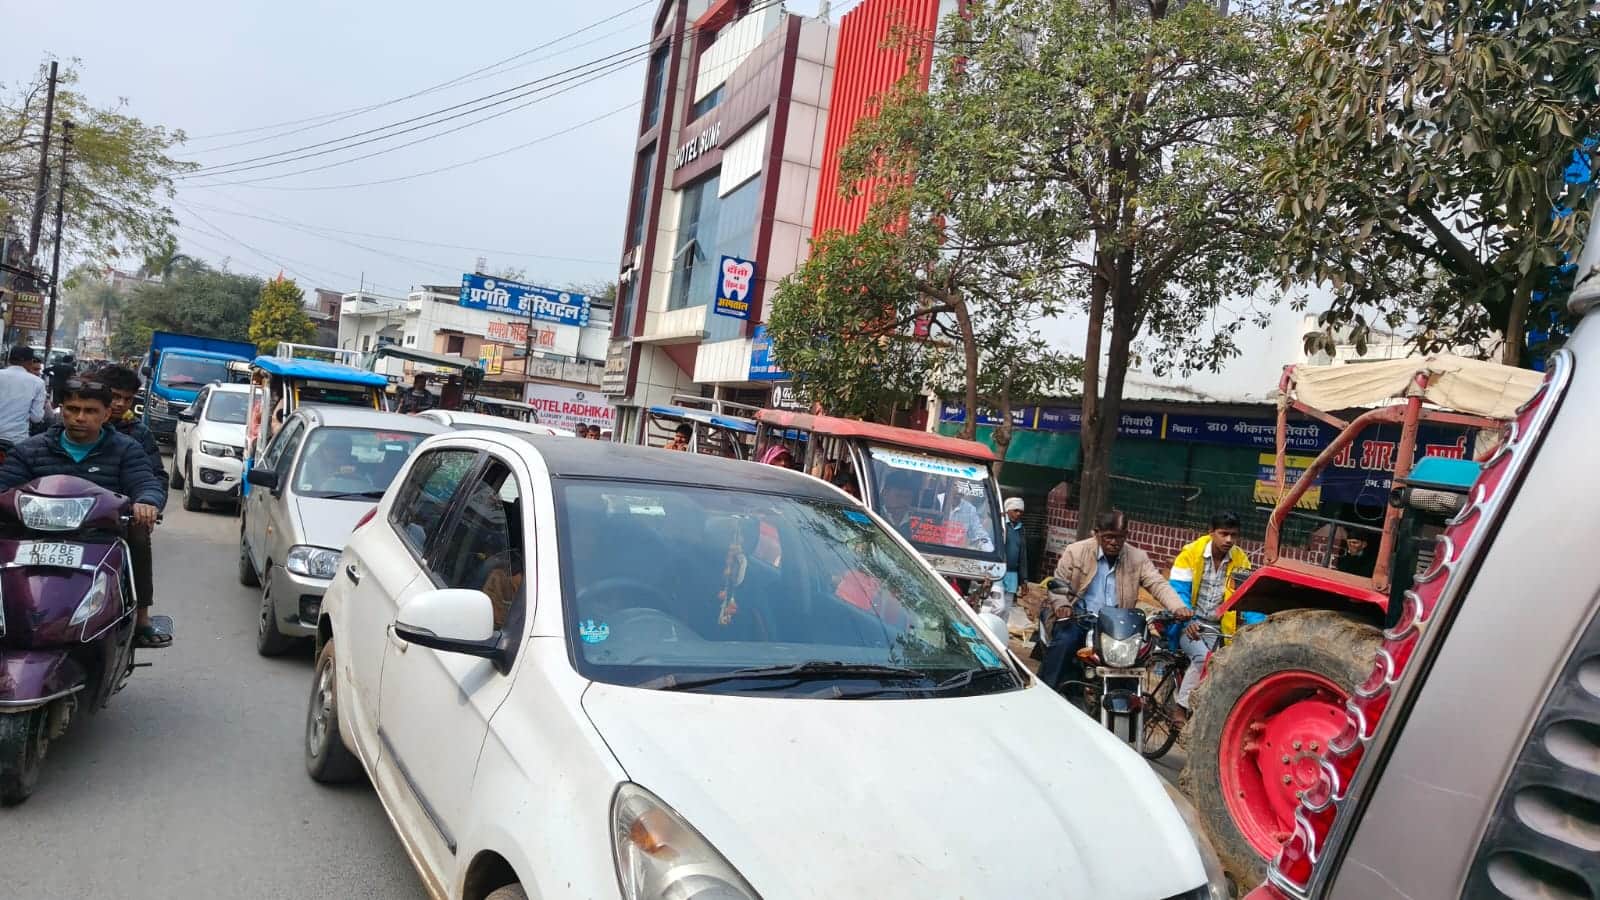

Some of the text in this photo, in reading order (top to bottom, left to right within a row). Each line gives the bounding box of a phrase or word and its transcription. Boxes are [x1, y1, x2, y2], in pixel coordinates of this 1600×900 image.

[673, 136, 699, 170] HOTEL
[470, 288, 511, 307] प्रगति
[717, 298, 749, 311] अस्पताल
[528, 398, 561, 414] HOTEL
[562, 402, 609, 419] RADHIKA
[1122, 415, 1154, 427] तिवारी
[891, 457, 961, 474] CCTV CAMERA
